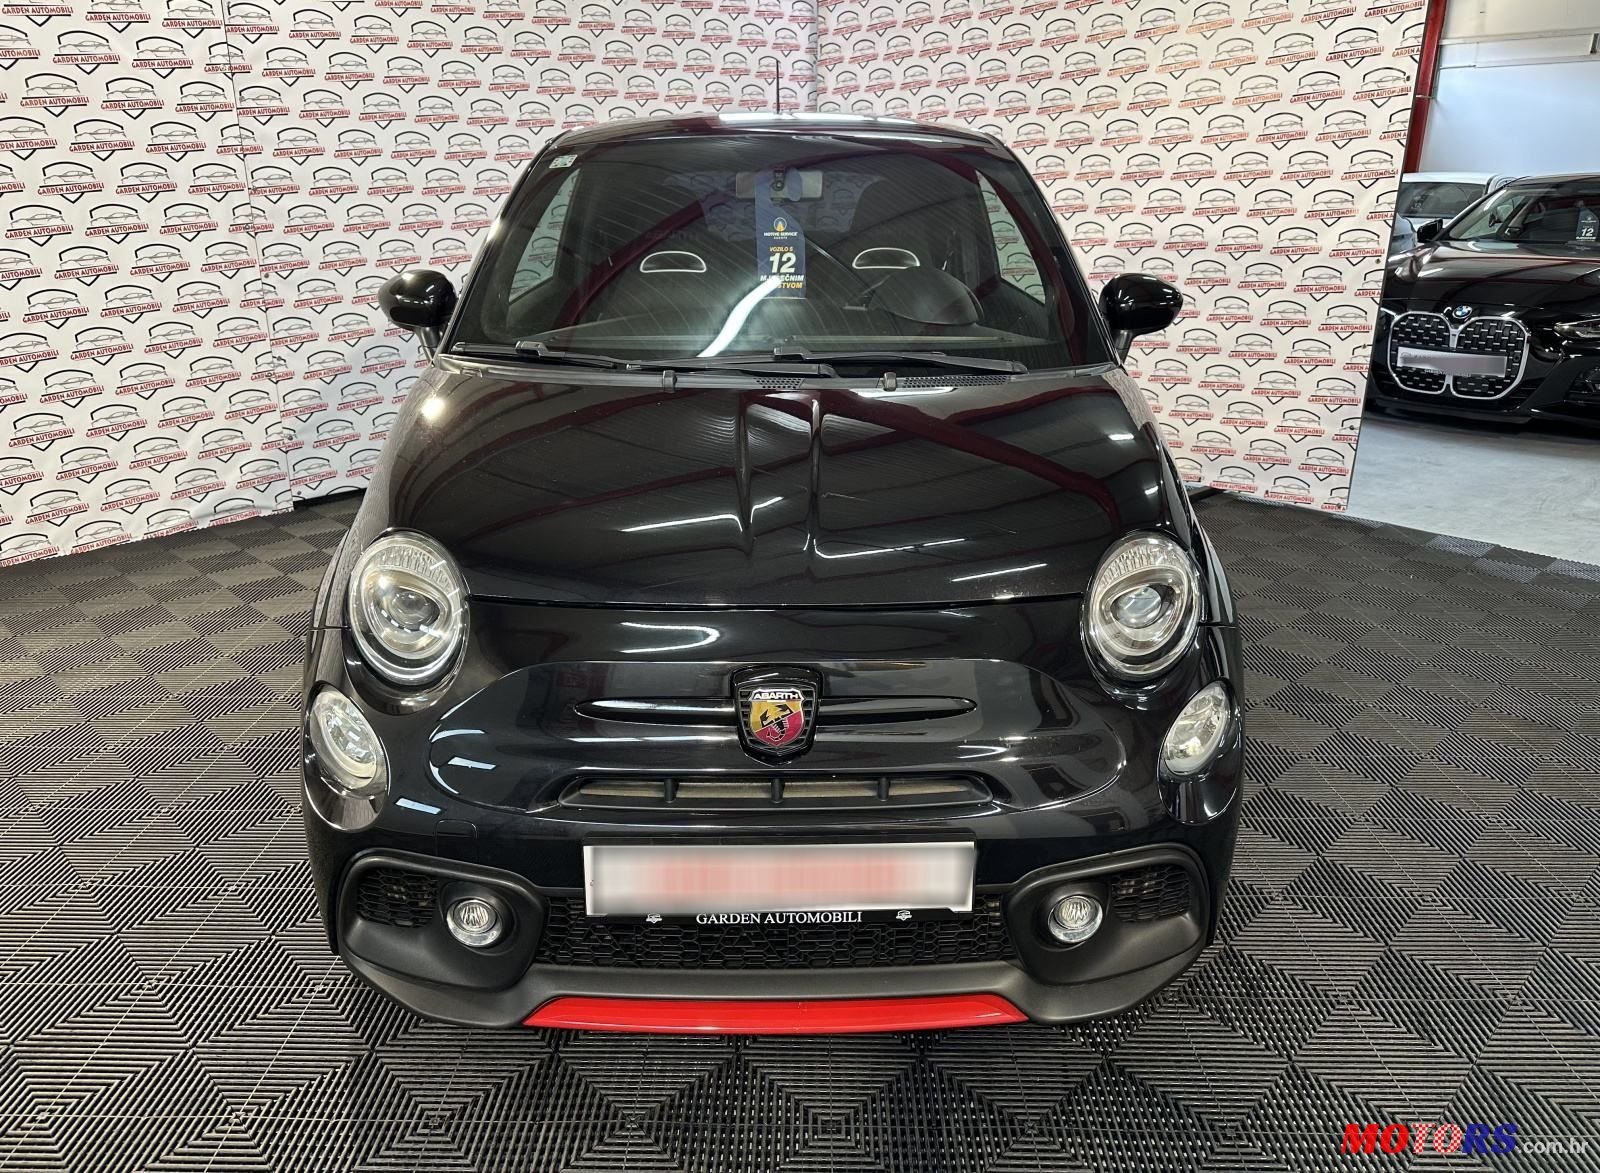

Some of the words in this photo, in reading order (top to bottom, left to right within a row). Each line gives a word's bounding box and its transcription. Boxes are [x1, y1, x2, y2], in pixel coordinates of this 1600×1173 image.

[1301, 14, 1322, 23] GARDEN
[1323, 7, 1356, 19] AUTOMOBILI
[1364, 7, 1388, 17] GARDEN
[1389, 0, 1425, 12] AUTOMOBILI
[1326, 52, 1348, 62] GARDEN
[1349, 46, 1384, 57] AUTOMOBILI
[1392, 48, 1415, 58] GARDEN
[284, 68, 316, 76] AUTOMOBILI
[48, 96, 89, 105] AUTOMOBILI
[1290, 95, 1310, 104] GARDEN
[1312, 89, 1345, 100] AUTOMOBILI
[1353, 92, 1375, 100] GARDEN
[100, 101, 126, 109] GARDEN
[127, 99, 165, 108] AUTOMOBILI
[199, 102, 236, 111] AUTOMOBILI
[1316, 134, 1336, 142] GARDEN
[1337, 129, 1371, 140] AUTOMOBILI
[16, 139, 58, 150] AUTOMOBILI
[69, 144, 94, 152] GARDEN
[96, 140, 135, 150] AUTOMOBILI
[145, 144, 169, 153] GARDEN
[170, 141, 207, 151] AUTOMOBILI
[272, 149, 293, 158] GARDEN
[294, 146, 326, 155] AUTOMOBILI
[37, 186, 64, 196] GARDEN
[65, 181, 104, 193] AUTOMOBILI
[116, 186, 140, 194] GARDEN
[141, 182, 178, 192] AUTOMOBILI
[188, 186, 211, 194] GARDEN
[212, 182, 247, 192] AUTOMOBILI
[1304, 211, 1325, 220] GARDEN
[1326, 207, 1358, 218] AUTOMOBILI
[1366, 212, 1385, 220] GARDEN
[5, 228, 32, 239] GARDEN
[33, 224, 74, 235] AUTOMOBILI
[85, 226, 109, 236] GARDEN
[111, 222, 149, 233] AUTOMOBILI
[159, 225, 182, 235] GARDEN
[183, 221, 219, 232] AUTOMOBILI
[1582, 228, 1594, 236] 12
[1351, 248, 1385, 257] AUTOMOBILI
[130, 266, 154, 276] GARDEN
[155, 261, 191, 272] AUTOMOBILI
[200, 263, 222, 273] GARDEN
[224, 257, 258, 270] AUTOMOBILI
[770, 252, 796, 273] 12
[1, 268, 43, 280] AUTOMOBILI
[54, 269, 80, 280] GARDEN
[81, 264, 119, 276] AUTOMOBILI
[100, 307, 124, 318] GARDEN
[125, 302, 162, 314] AUTOMOBILI
[172, 304, 194, 314] GARDEN
[196, 298, 230, 310] AUTOMOBILI
[22, 312, 48, 323] GARDEN
[50, 305, 89, 319] AUTOMOBILI
[144, 343, 167, 354] GARDEN
[168, 337, 203, 350] AUTOMOBILI
[212, 338, 234, 348] GARDEN
[235, 332, 269, 344] AUTOMOBILI
[19, 350, 59, 362] AUTOMOBILI
[70, 349, 95, 361] GARDEN
[96, 342, 134, 356] AUTOMOBILI
[115, 384, 138, 396] GARDEN
[140, 377, 176, 391] AUTOMOBILI
[185, 377, 207, 389] GARDEN
[208, 370, 242, 384] AUTOMOBILI
[40, 392, 65, 404] GARDEN
[66, 384, 104, 398] AUTOMOBILI
[224, 410, 245, 421] GARDEN
[246, 402, 278, 416] AUTOMOBILI
[157, 418, 180, 430] GARDEN
[181, 410, 215, 424] AUTOMOBILI
[86, 426, 110, 439] GARDEN
[111, 417, 148, 433] AUTOMOBILI
[8, 435, 34, 448] GARDEN
[35, 426, 75, 442] AUTOMOBILI
[197, 449, 218, 461] GARDEN
[219, 441, 252, 456] AUTOMOBILI
[129, 458, 152, 470] GARDEN
[153, 450, 188, 465] AUTOMOBILI
[56, 468, 80, 482] GARDEN
[81, 459, 118, 475] AUTOMOBILI
[4, 472, 44, 486] AUTOMOBILI
[170, 489, 192, 501] GARDEN
[192, 480, 226, 495] AUTOMOBILI
[100, 500, 123, 512] GARDEN
[125, 490, 161, 506] AUTOMOBILI
[25, 512, 50, 526] GARDEN
[51, 501, 90, 518] AUTOMOBILI
[71, 542, 94, 556] GARDEN
[96, 532, 132, 549] AUTOMOBILI
[21, 546, 59, 561] AUTOMOBILI
[696, 913, 760, 925] GARDEN
[764, 912, 862, 924] AUTOMOBILI
